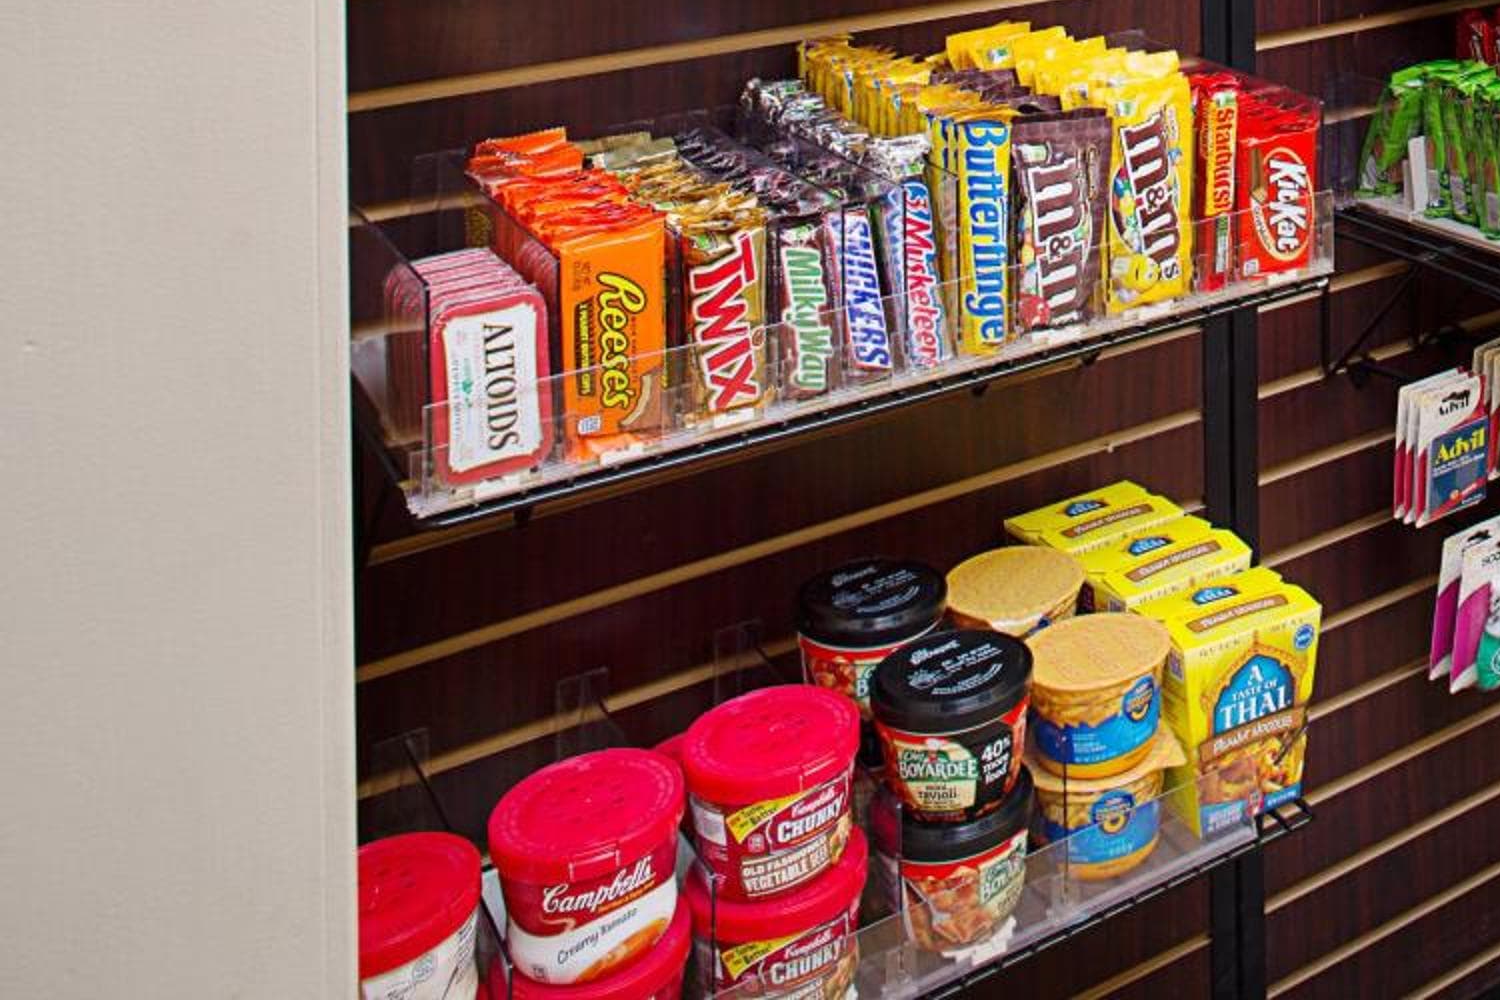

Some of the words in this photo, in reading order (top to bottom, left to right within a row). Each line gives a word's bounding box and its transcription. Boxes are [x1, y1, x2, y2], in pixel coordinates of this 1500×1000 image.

[964, 120, 1010, 342] Butterfinge
[690, 232, 759, 410] TWIX
[785, 248, 827, 321] Milky
[844, 215, 890, 369] SNICKERS
[596, 271, 649, 409] Reese's
[792, 322, 831, 390] Way
[482, 322, 520, 451] ALTOIDS
[1248, 664, 1264, 685] A
[899, 757, 980, 780] BOYARDEE
[776, 794, 846, 843] CHUNKY
[556, 930, 600, 965] Creamy
